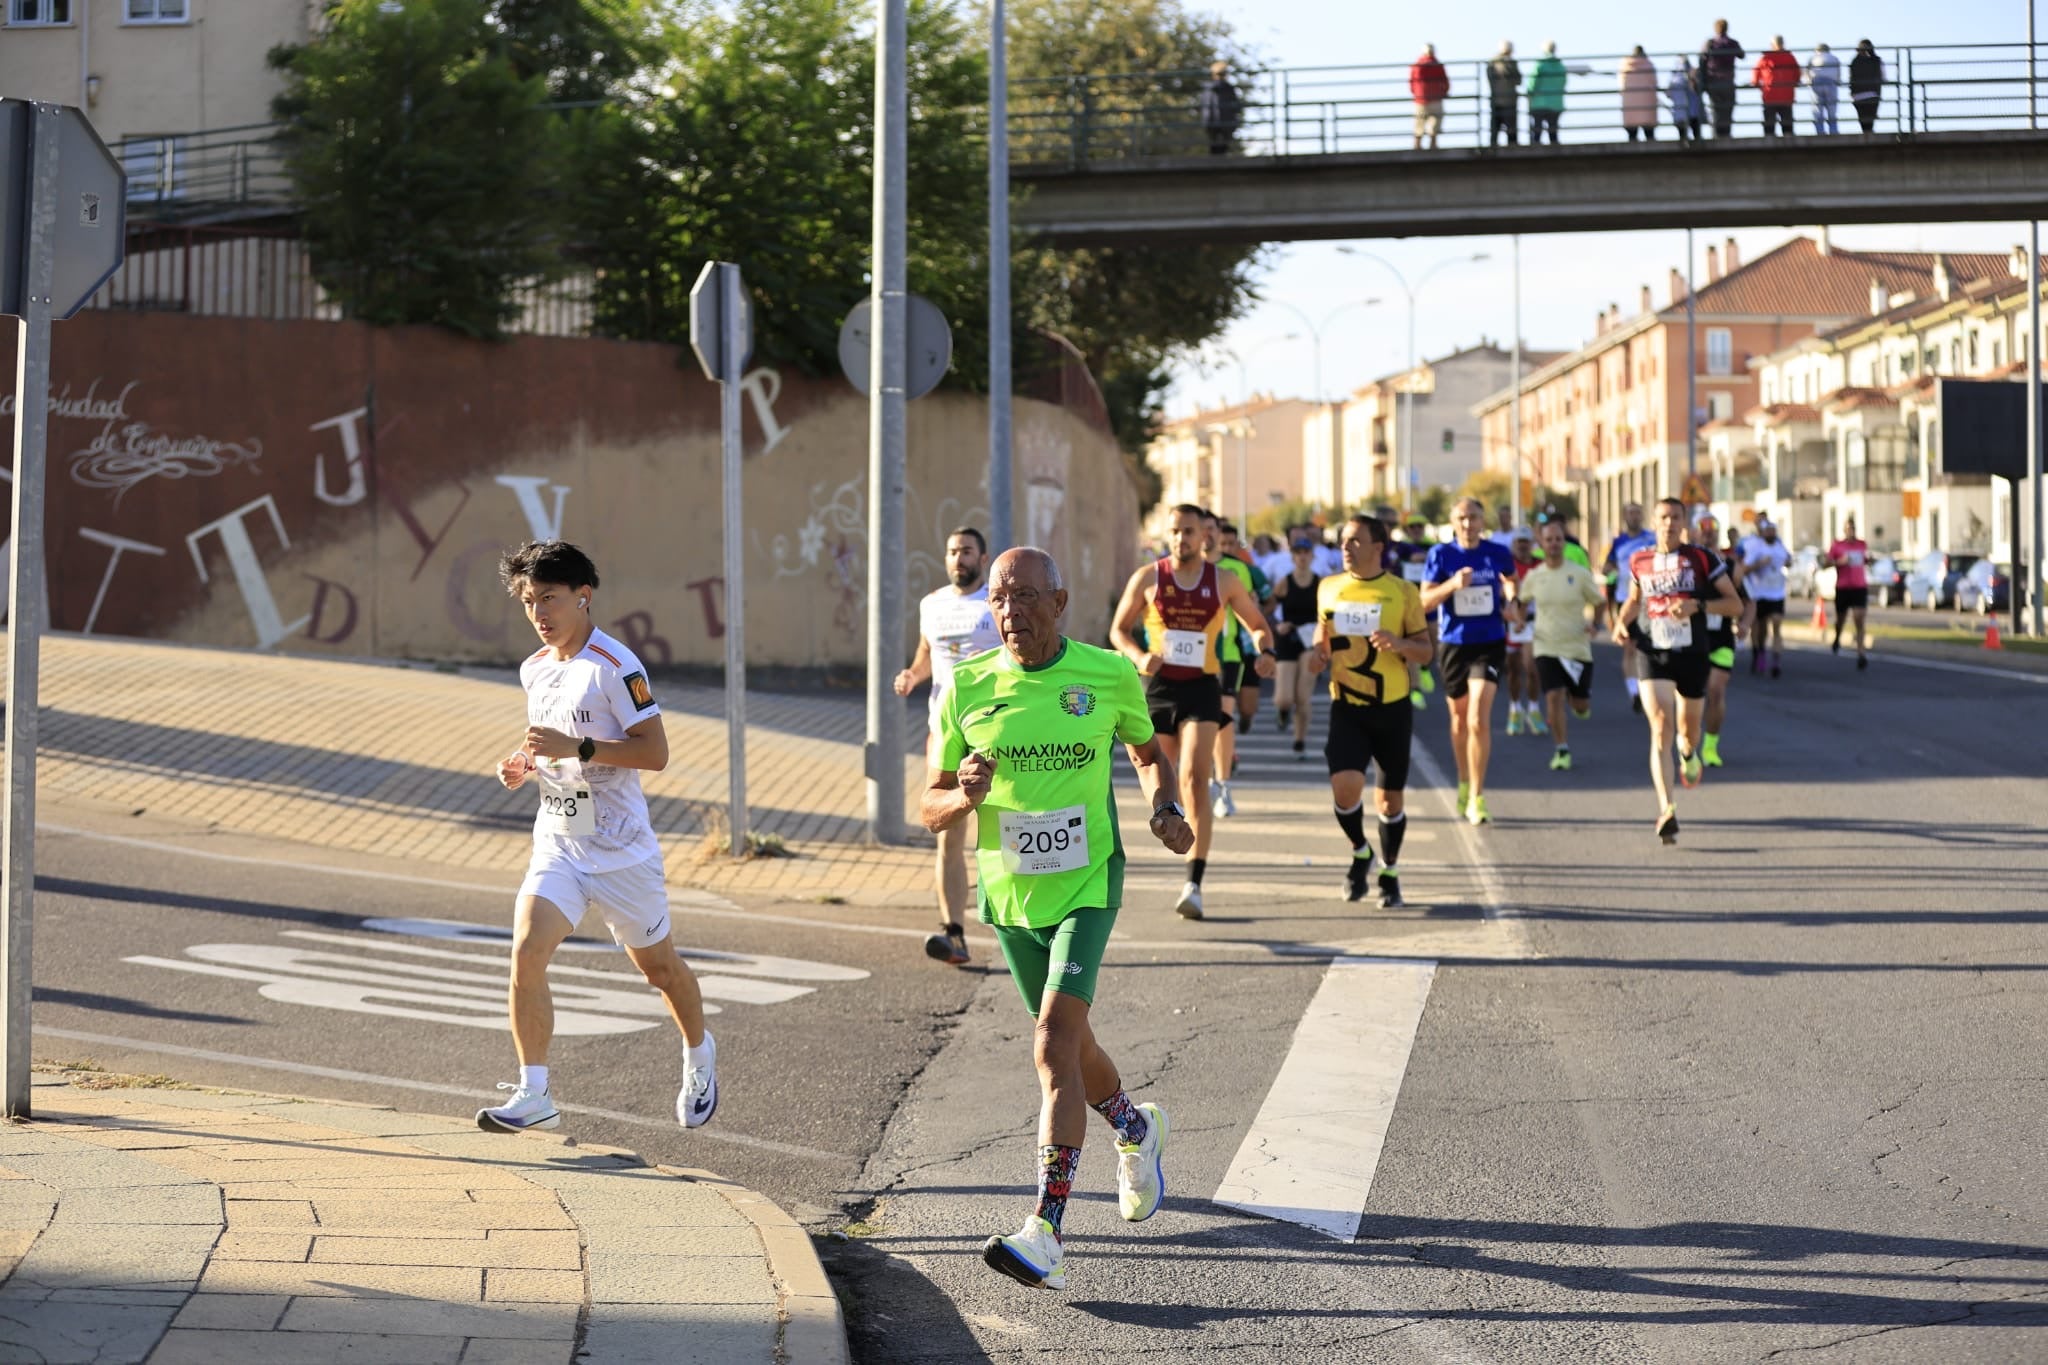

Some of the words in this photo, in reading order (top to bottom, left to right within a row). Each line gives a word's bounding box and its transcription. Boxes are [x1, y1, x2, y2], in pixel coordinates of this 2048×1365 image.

[1345, 612, 1369, 625] 151
[1175, 642, 1193, 655] 40
[985, 742, 1087, 760] ANMAXIMO
[1013, 757, 1078, 772] TELECOM
[545, 795, 578, 817] 223
[1018, 828, 1069, 854] 209
